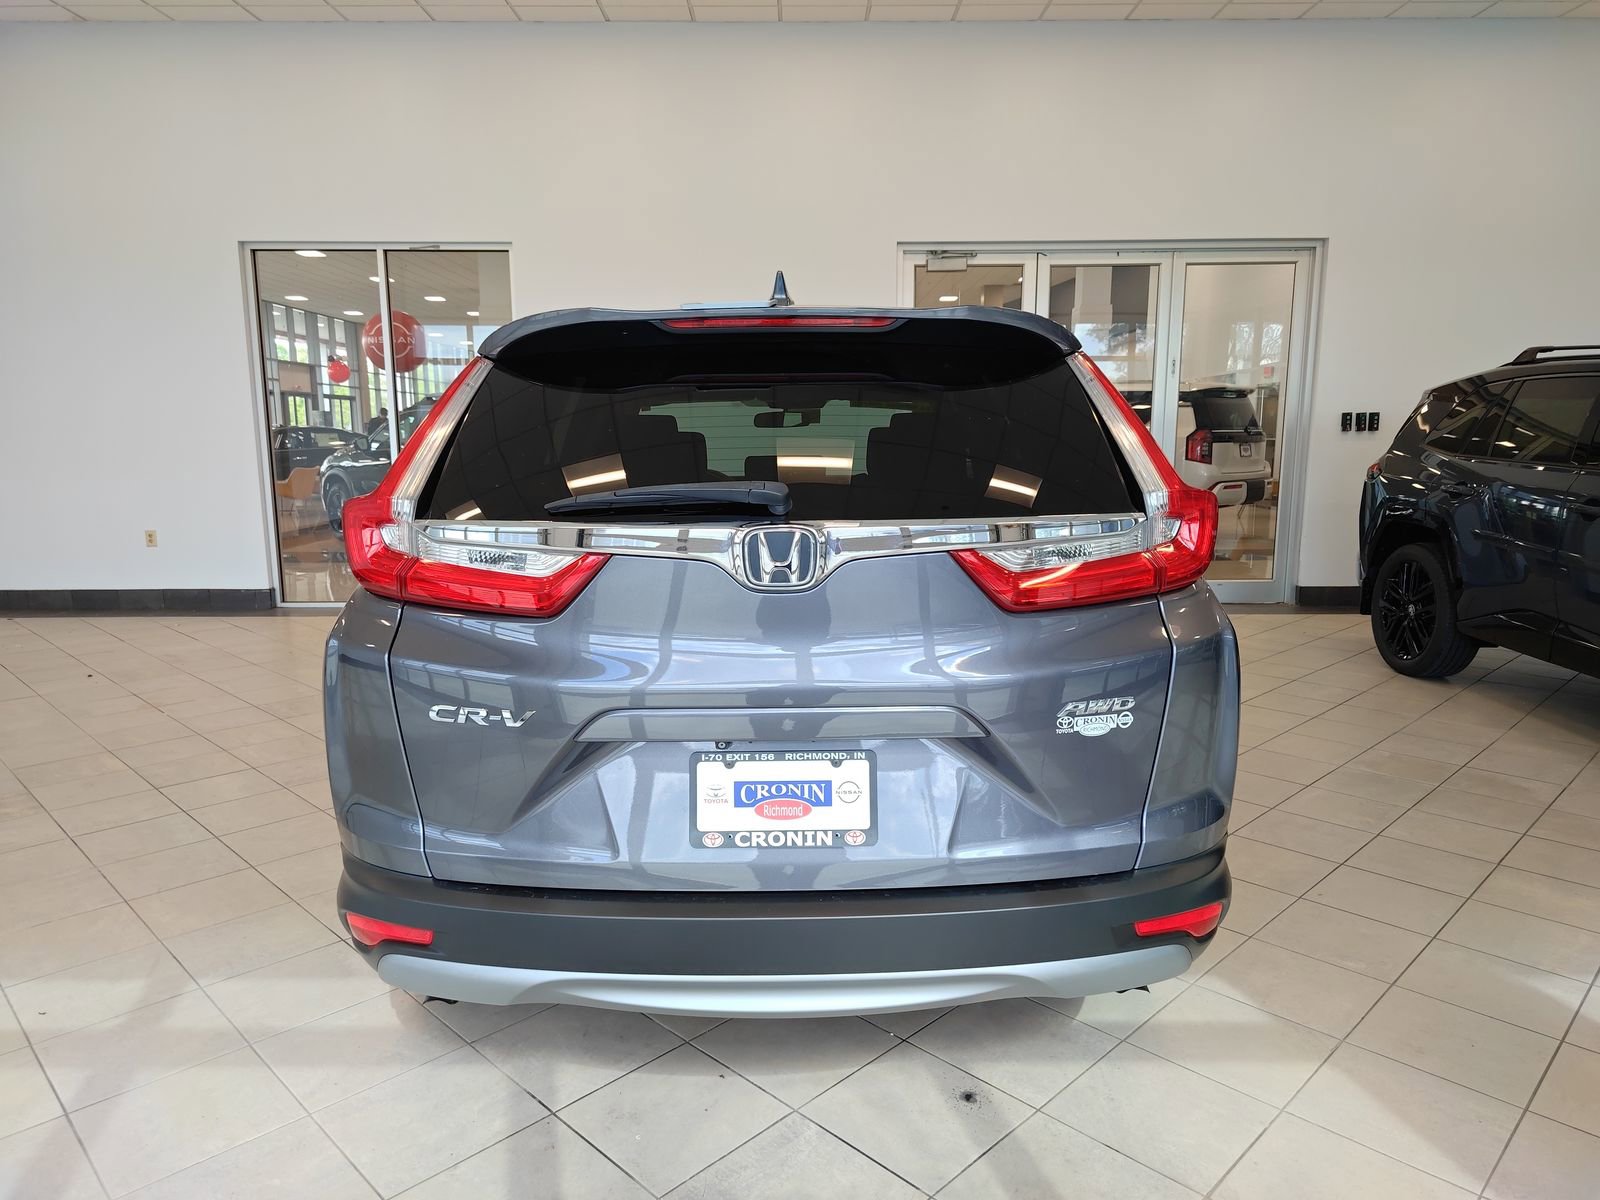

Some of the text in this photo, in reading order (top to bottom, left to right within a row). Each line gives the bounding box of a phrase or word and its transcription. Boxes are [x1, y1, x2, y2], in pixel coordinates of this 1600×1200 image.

[367, 336, 415, 344] NISAN
[1056, 696, 1136, 717] AWD
[428, 704, 537, 727] CR-V
[1075, 715, 1117, 727] CRONIN
[726, 753, 751, 761] EXIT
[754, 753, 775, 761] 156
[853, 752, 866, 760] IN
[740, 783, 826, 804] CRONIN
[763, 804, 803, 817] Richmond
[734, 830, 833, 847] CRONIN
